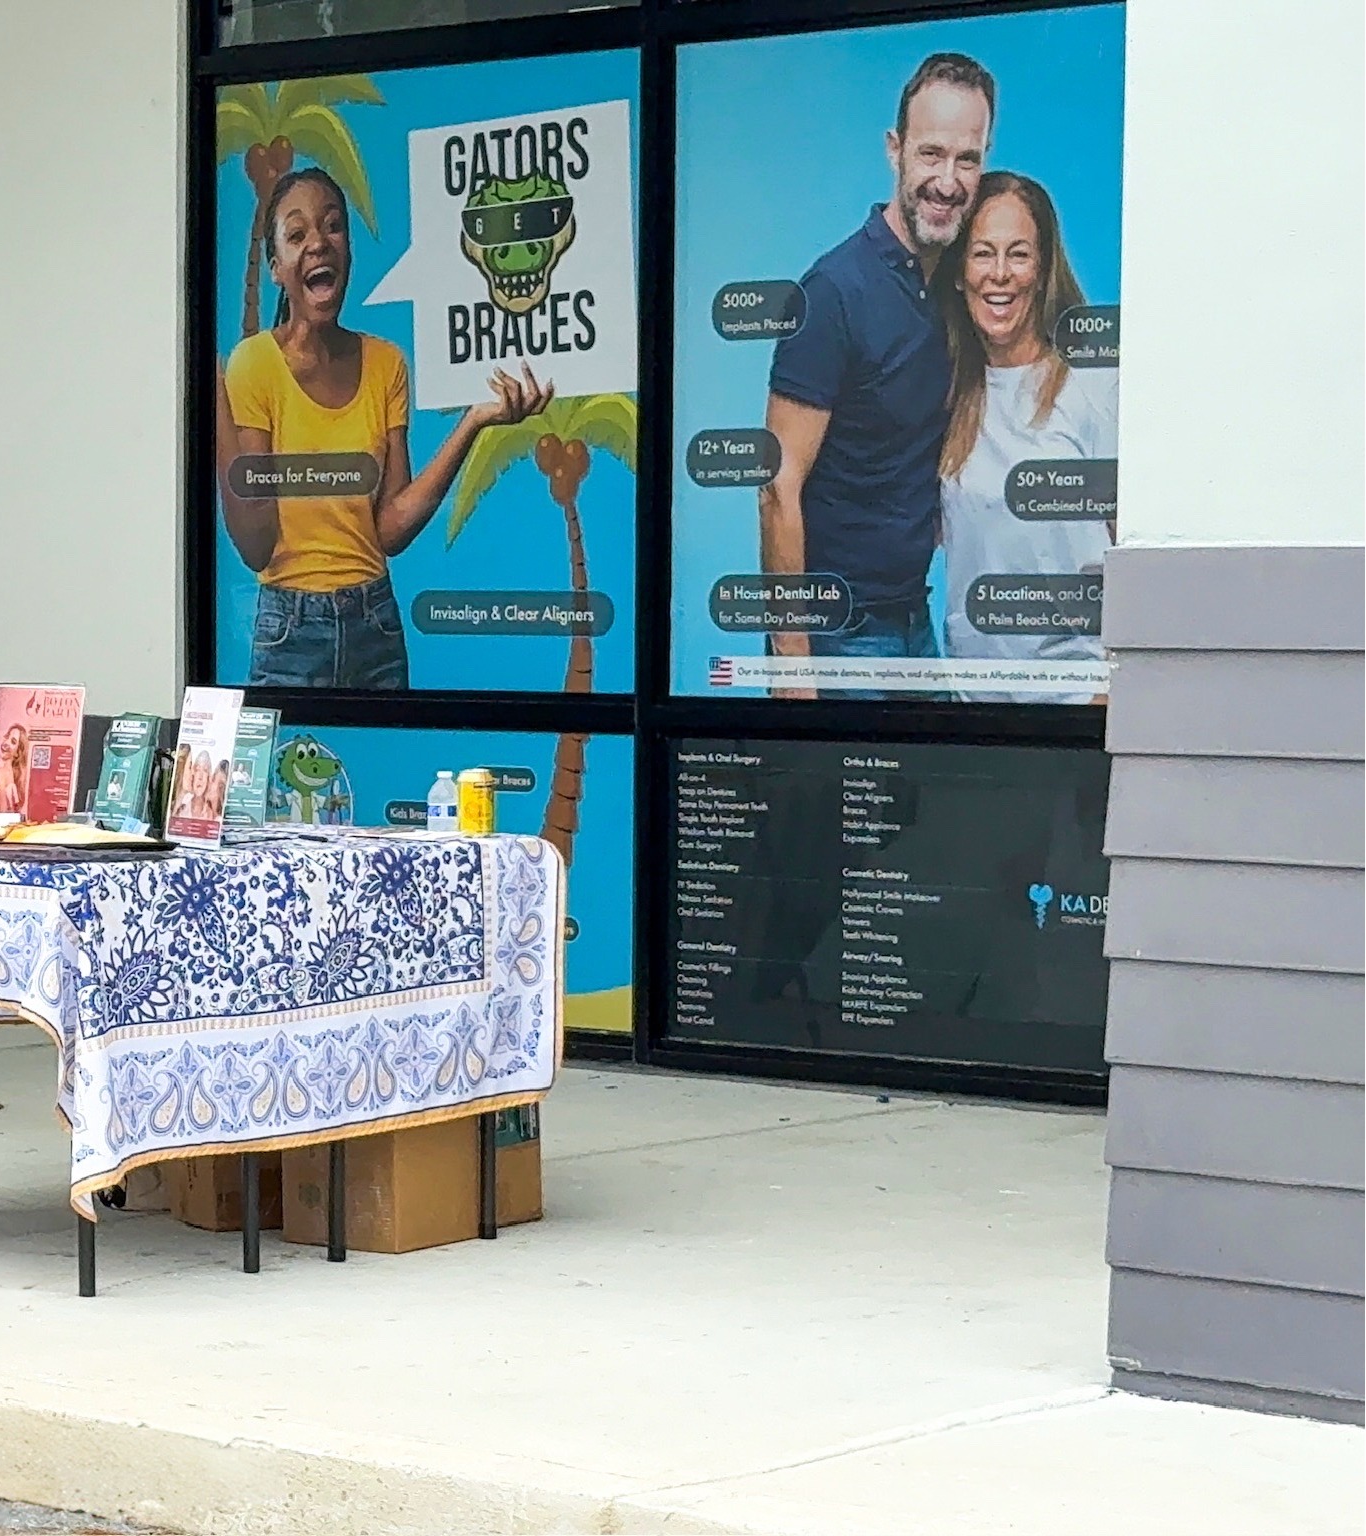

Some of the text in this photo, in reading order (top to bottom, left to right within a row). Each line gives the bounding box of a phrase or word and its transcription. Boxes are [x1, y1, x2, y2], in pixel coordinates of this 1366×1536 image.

[444, 118, 590, 196] GATORS
[476, 207, 560, 235] GET
[722, 293, 764, 308] 5000+
[447, 289, 596, 365] BRACES
[722, 318, 797, 335] Implants Placed
[1069, 318, 1113, 333] 1000+
[1066, 346, 1096, 359] Smile
[698, 440, 755, 455] 12+ Years
[246, 467, 361, 487] Braces for Everyone
[696, 466, 771, 482] in serving smiles
[1017, 471, 1084, 487] 50+ Years
[1016, 500, 1025, 513] in
[1028, 499, 1083, 513] Combined
[719, 584, 840, 600] In House Dental Lab
[976, 585, 986, 601] 5
[990, 584, 1054, 602] Locations,
[1058, 584, 1083, 600] and
[430, 605, 594, 624] Invisalign & Clear Aligners
[719, 611, 828, 627] for Same Day Dentistry
[976, 612, 1091, 629] in Palm Beach County
[503, 775, 531, 786] Braces
[390, 808, 407, 818] Kids
[1061, 894, 1086, 912] KA
